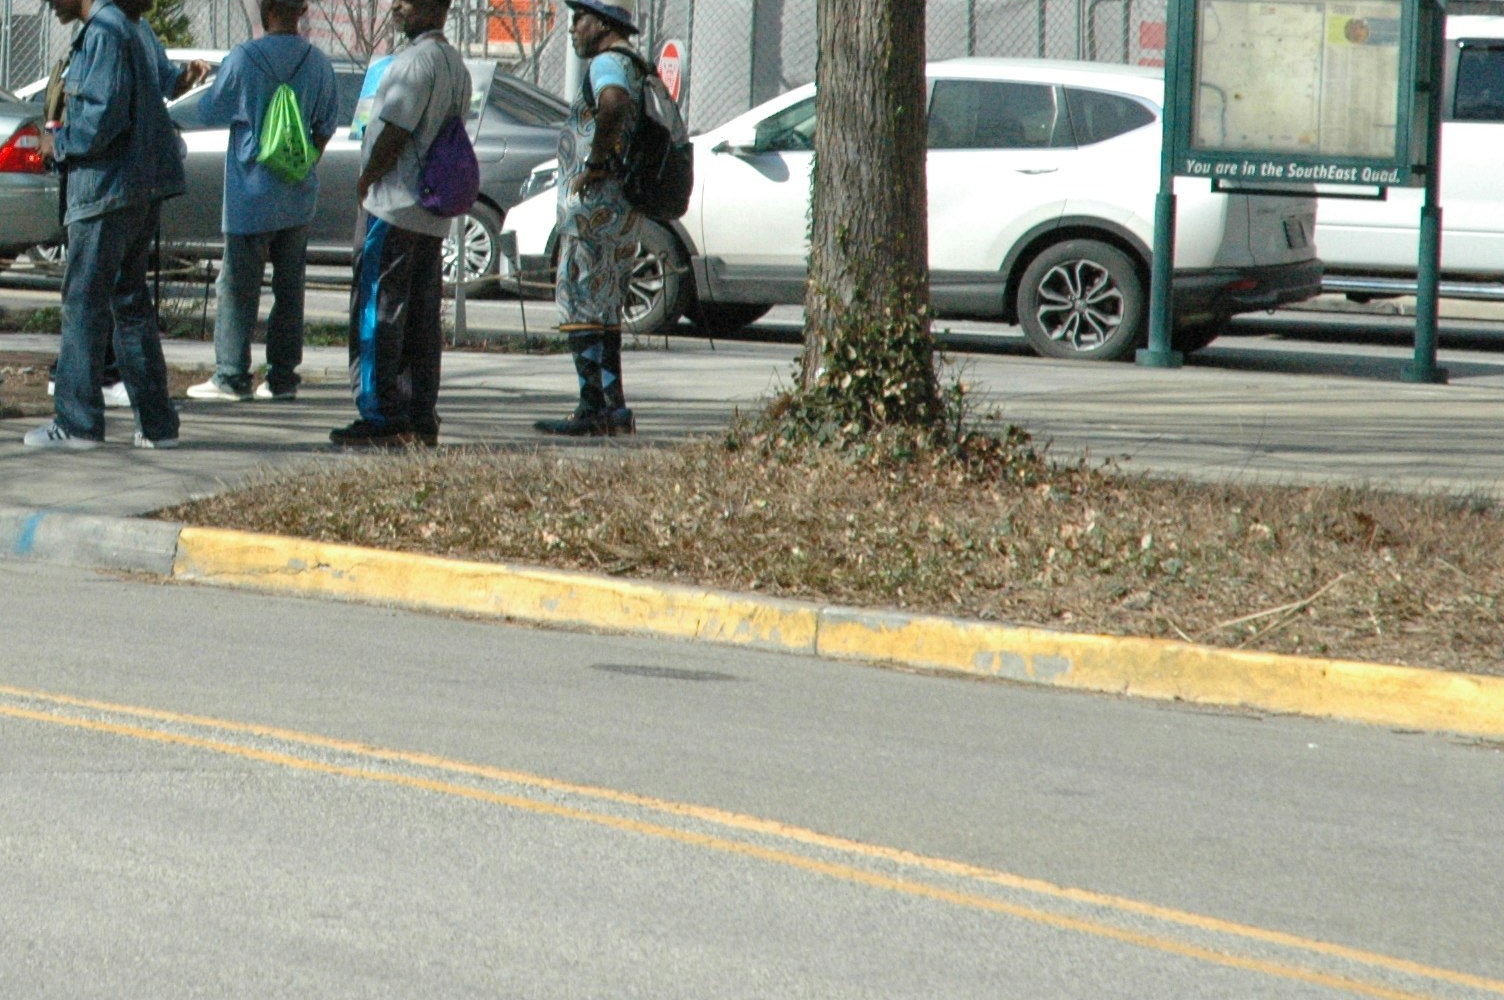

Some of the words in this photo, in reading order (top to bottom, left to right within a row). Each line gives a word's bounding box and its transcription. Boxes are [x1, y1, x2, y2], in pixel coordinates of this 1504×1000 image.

[1186, 159, 1211, 174] You
[1215, 163, 1238, 175] are
[1242, 161, 1256, 176] in
[1261, 162, 1283, 177] the
[1287, 163, 1357, 181] SouthEast
[1361, 167, 1401, 183] Quad.
